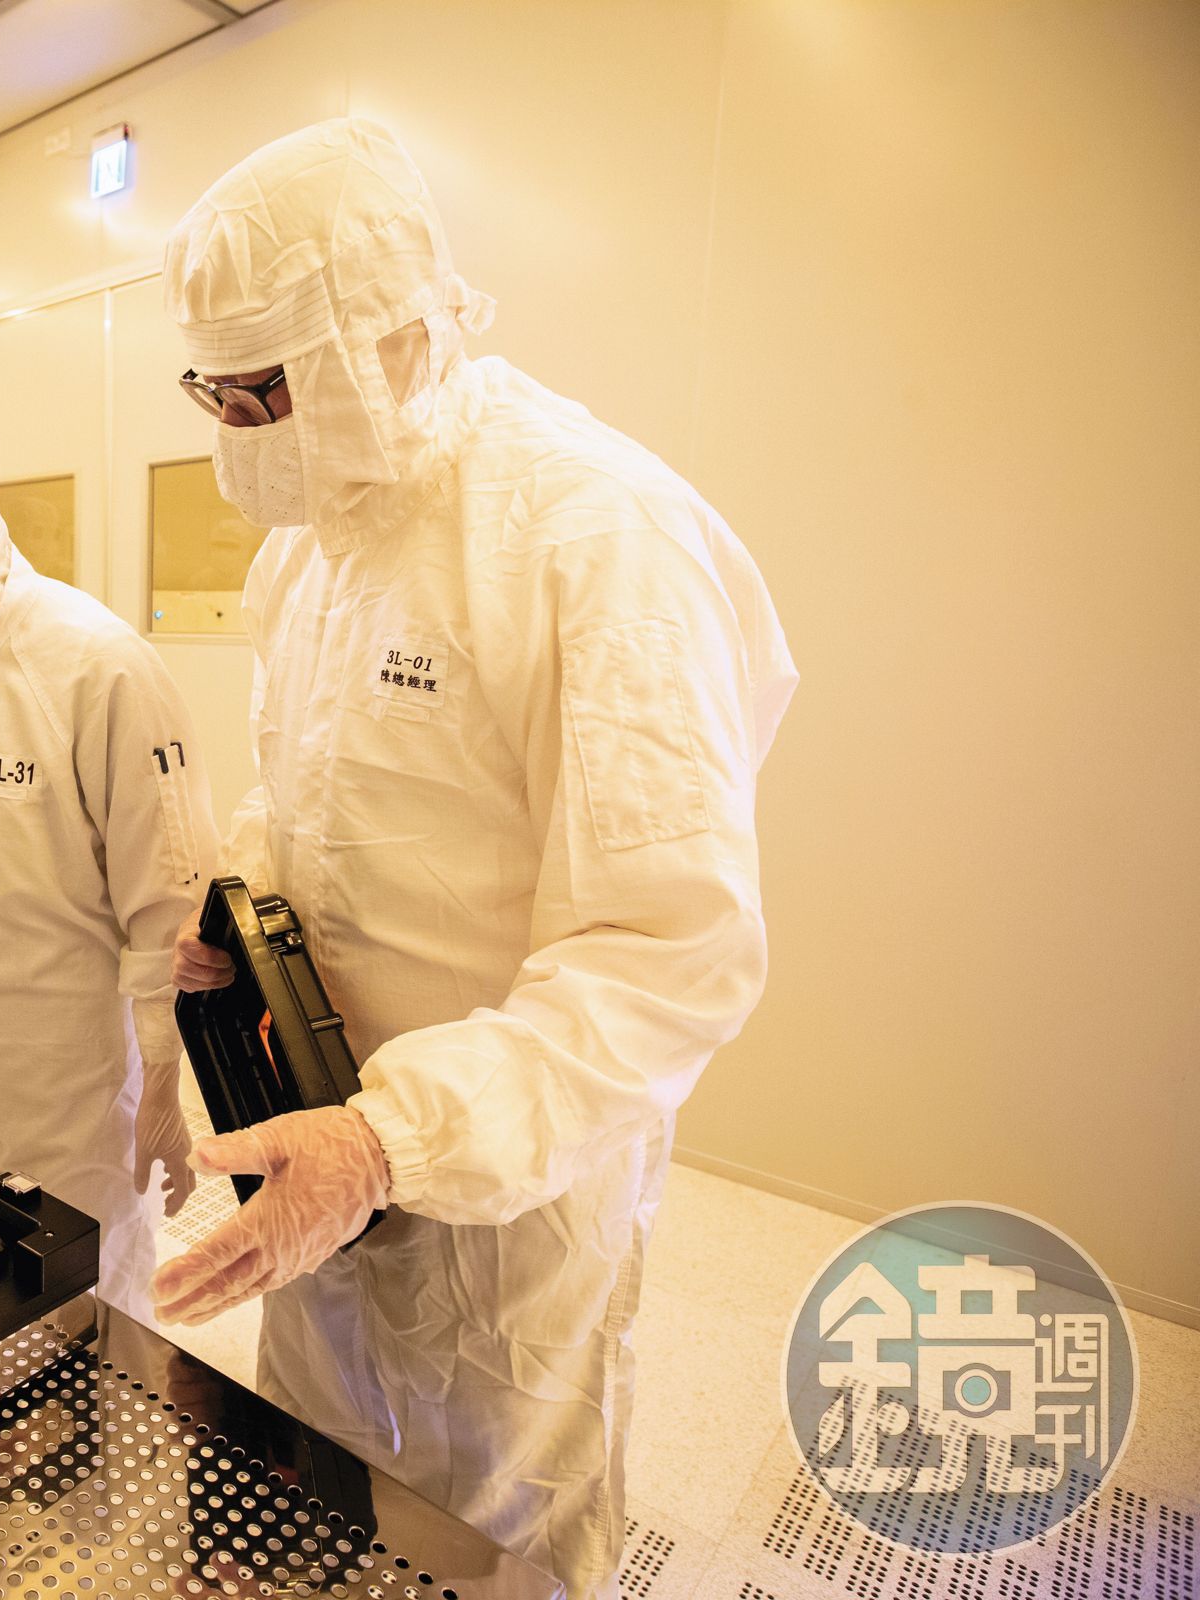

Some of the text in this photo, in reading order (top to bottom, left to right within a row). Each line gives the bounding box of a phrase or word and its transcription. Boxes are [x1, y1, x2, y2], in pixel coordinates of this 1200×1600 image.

[386, 650, 432, 672] 3L-01
[380, 669, 437, 692] 陳總經理
